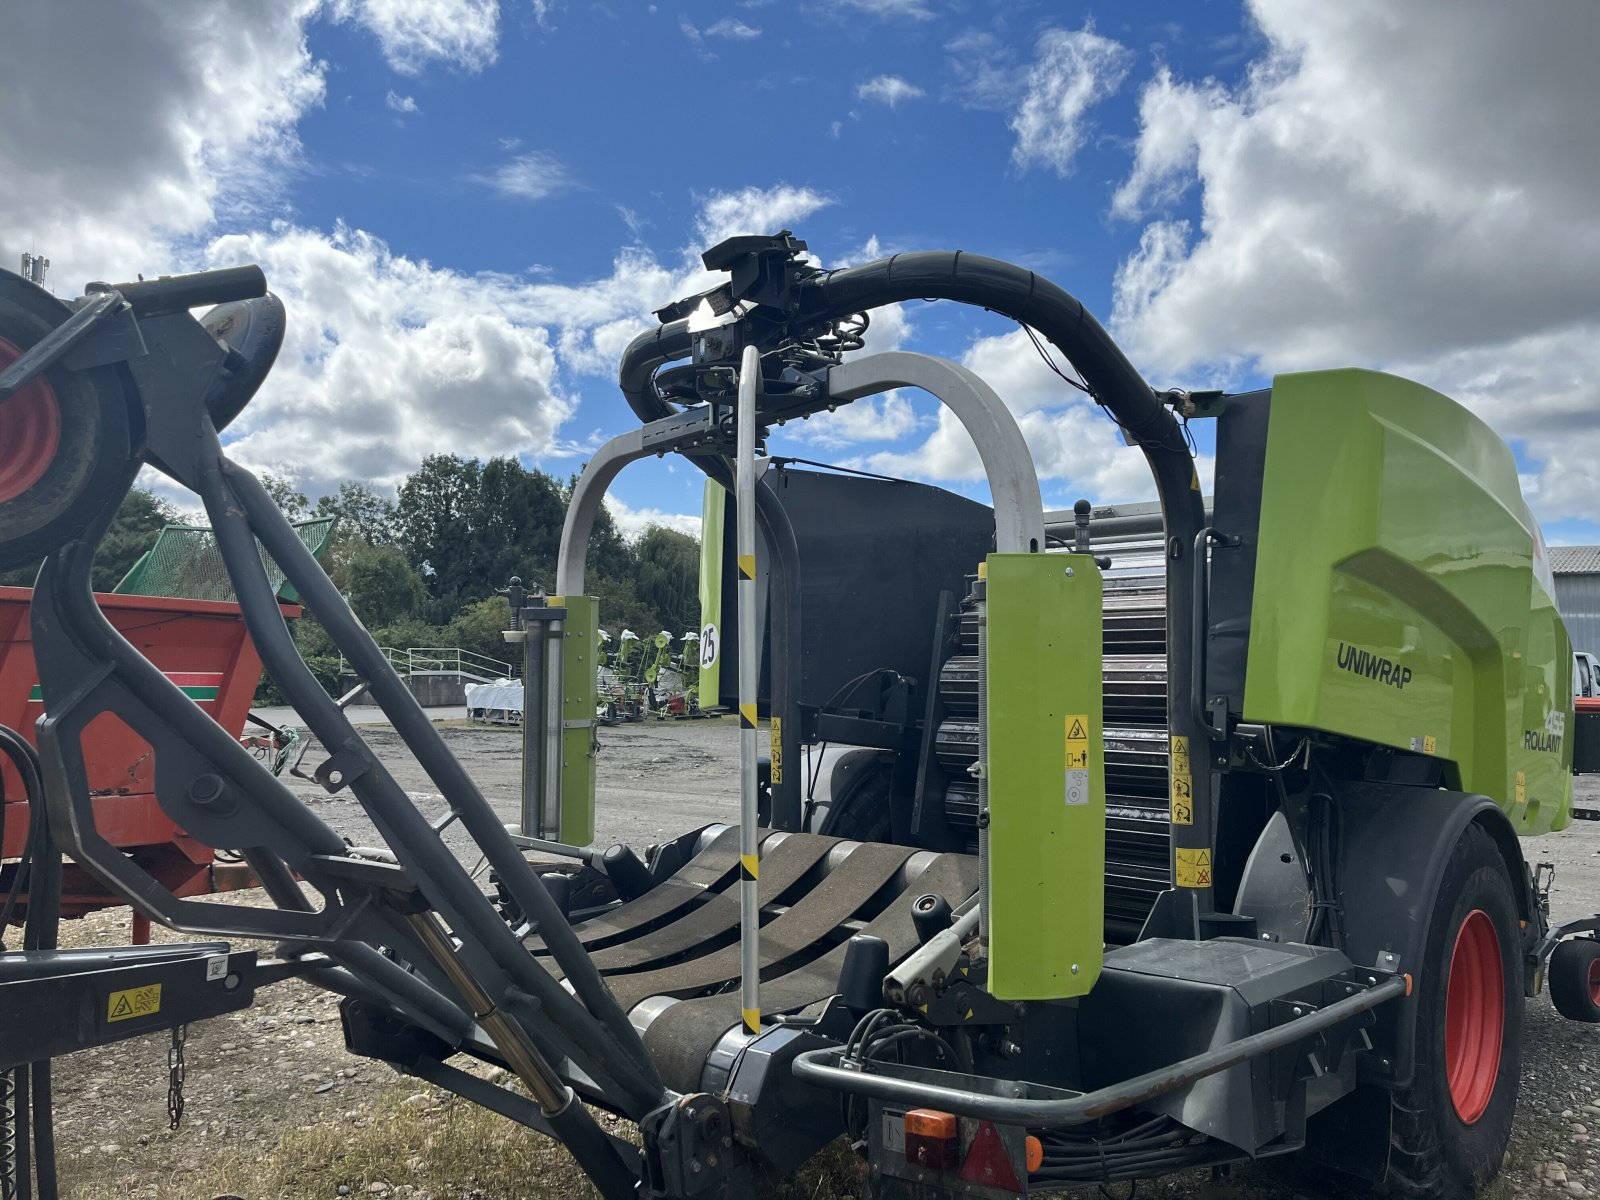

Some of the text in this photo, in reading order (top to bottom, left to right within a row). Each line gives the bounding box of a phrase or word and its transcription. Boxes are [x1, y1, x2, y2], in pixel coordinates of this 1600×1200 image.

[702, 627, 715, 666] 25
[1337, 642, 1412, 690] UNIWRAP
[1545, 709, 1565, 736] 455
[1524, 730, 1561, 753] ROLLANT
